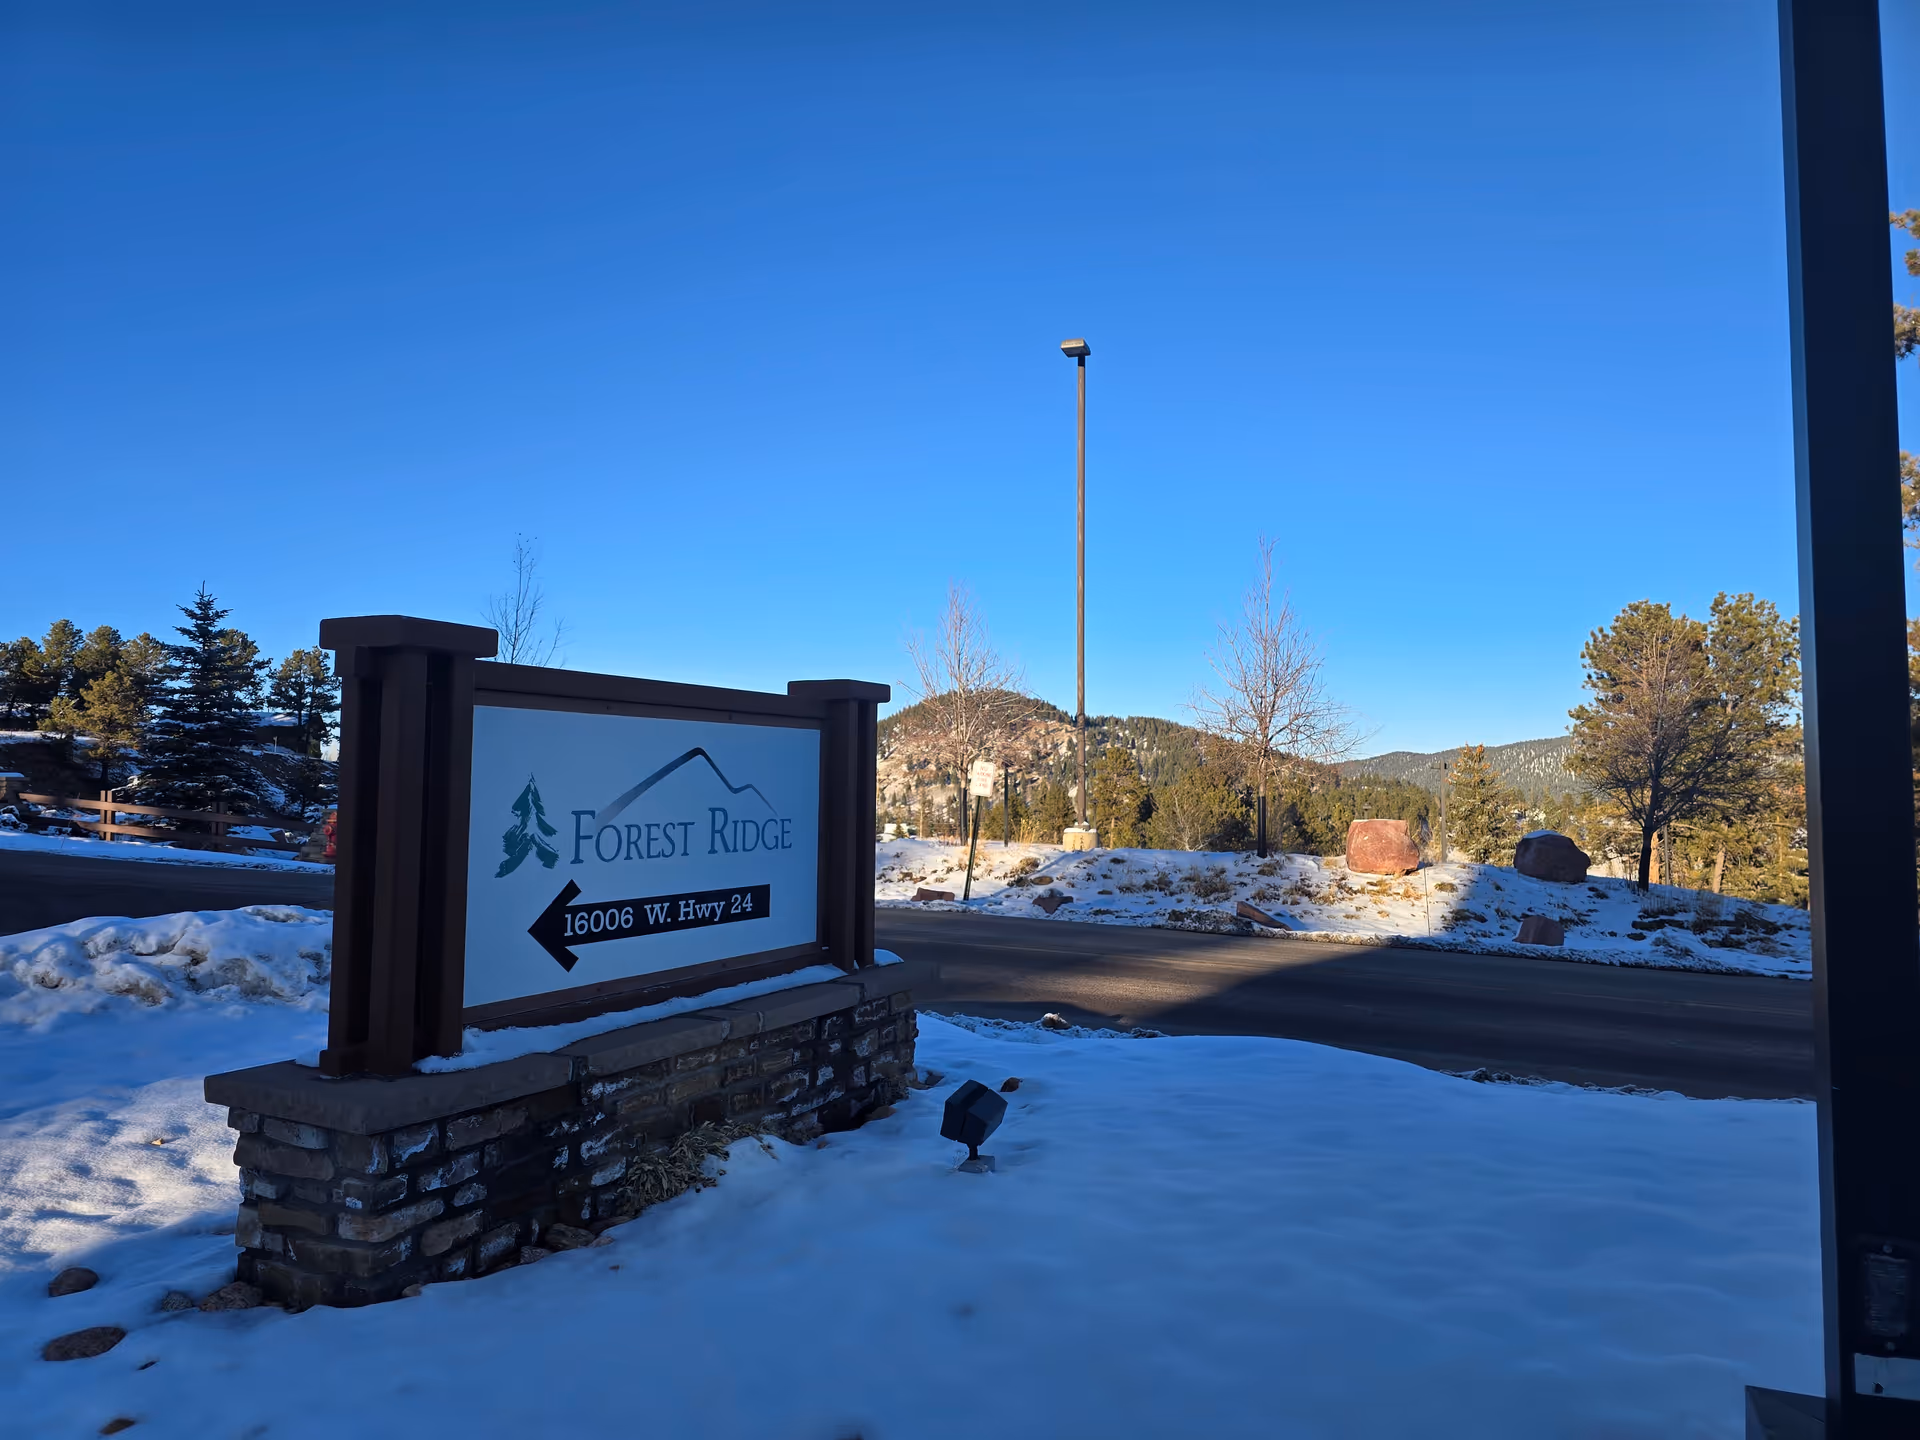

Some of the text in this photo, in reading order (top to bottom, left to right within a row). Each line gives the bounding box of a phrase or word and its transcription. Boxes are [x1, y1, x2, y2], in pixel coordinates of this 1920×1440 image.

[570, 807, 793, 864] FOREST RIDGE
[563, 892, 753, 937] 16006 W. Hwy 24
